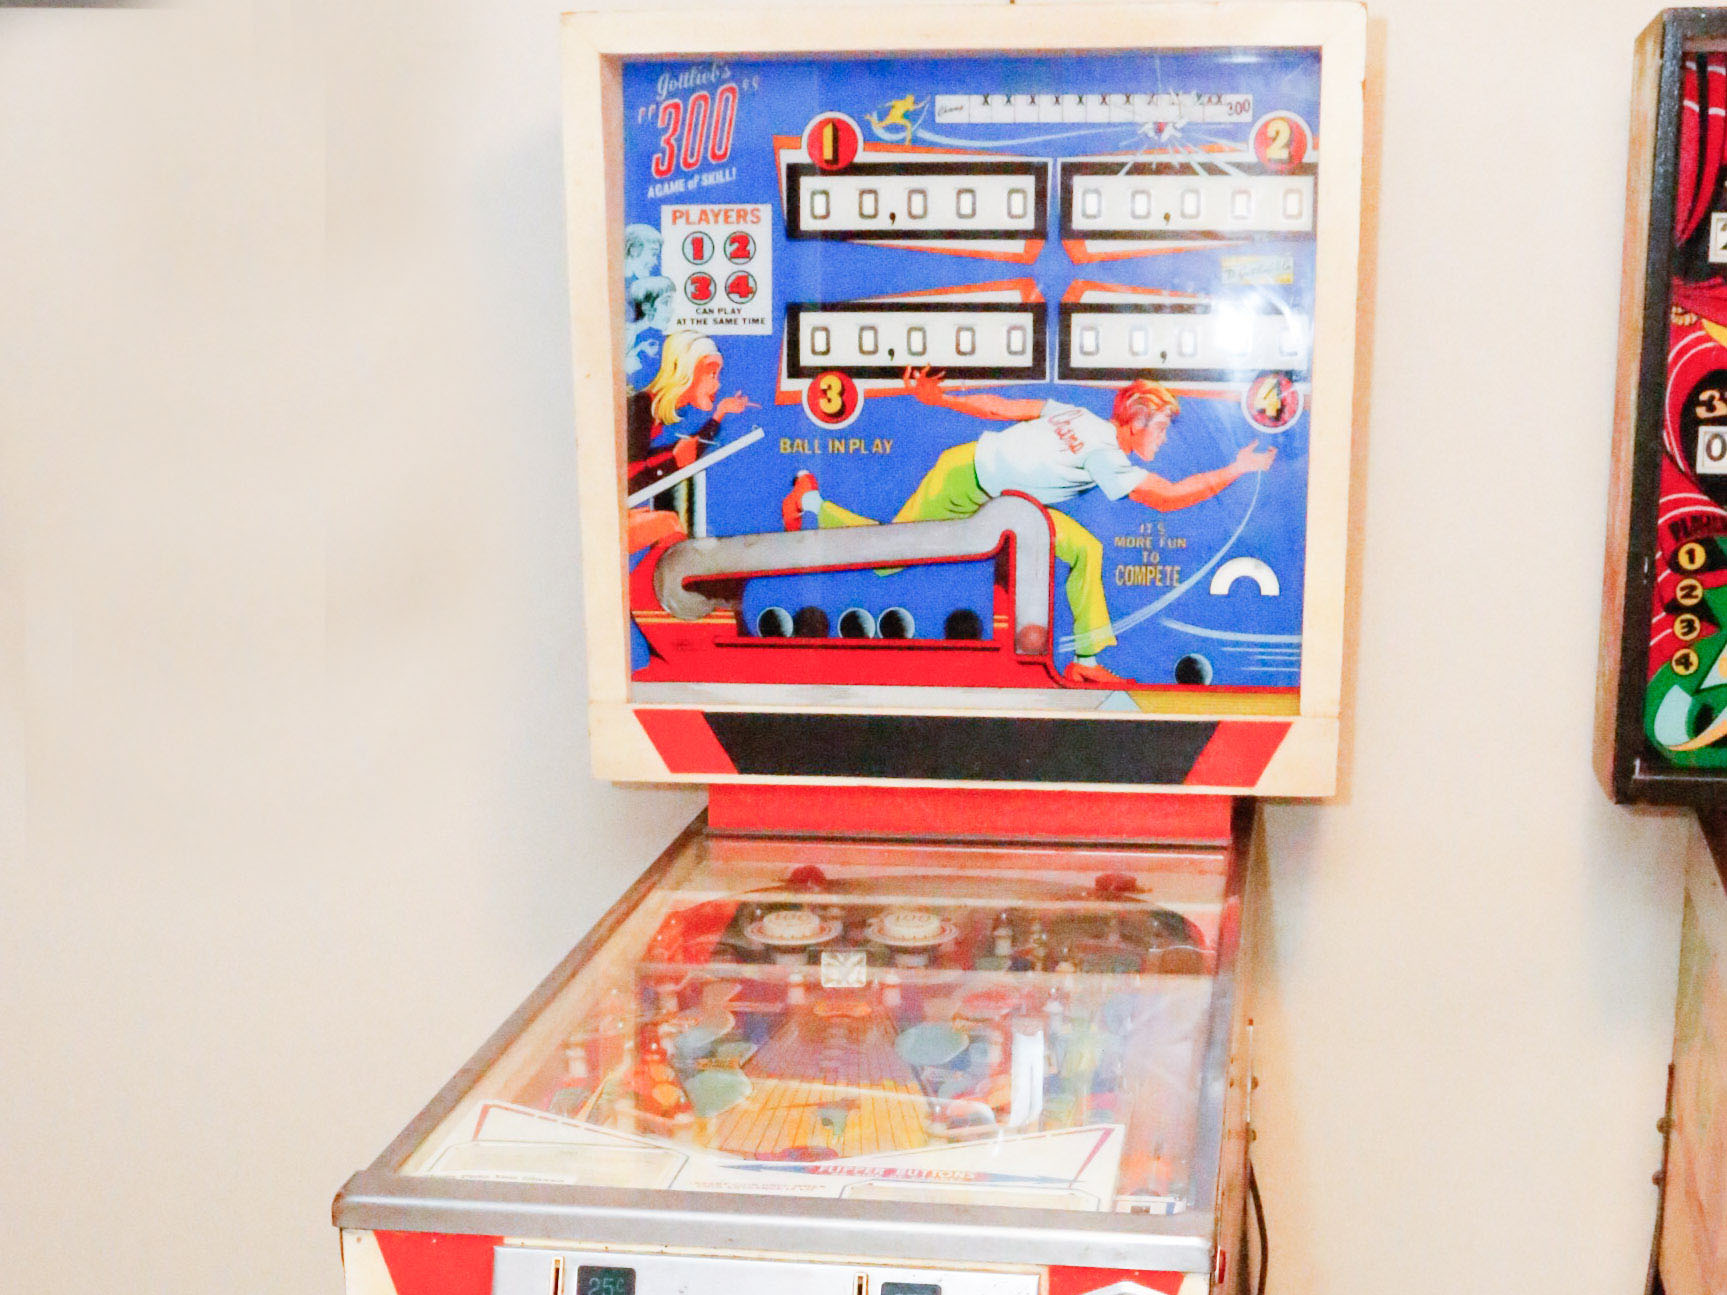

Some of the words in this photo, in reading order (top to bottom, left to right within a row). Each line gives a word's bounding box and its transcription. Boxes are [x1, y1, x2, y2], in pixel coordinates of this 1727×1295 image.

[1266, 117, 1292, 161] 2
[671, 208, 761, 226] PLAYERS
[691, 237, 704, 260] 1
[729, 234, 750, 259] 2
[691, 276, 711, 301] 3
[728, 275, 754, 298] 4
[695, 307, 714, 315] CAN
[717, 307, 742, 315] PLAY
[743, 317, 765, 325] TIME
[819, 374, 845, 416] 3
[779, 437, 821, 454] BALL
[828, 437, 845, 454] IN
[848, 437, 894, 454] PLAY
[1114, 536, 1152, 549] MORE
[1142, 550, 1160, 564] TO
[1115, 564, 1181, 587] COMPETE
[1679, 584, 1699, 600] 2
[1680, 619, 1698, 637] 3
[1674, 652, 1694, 671] 4
